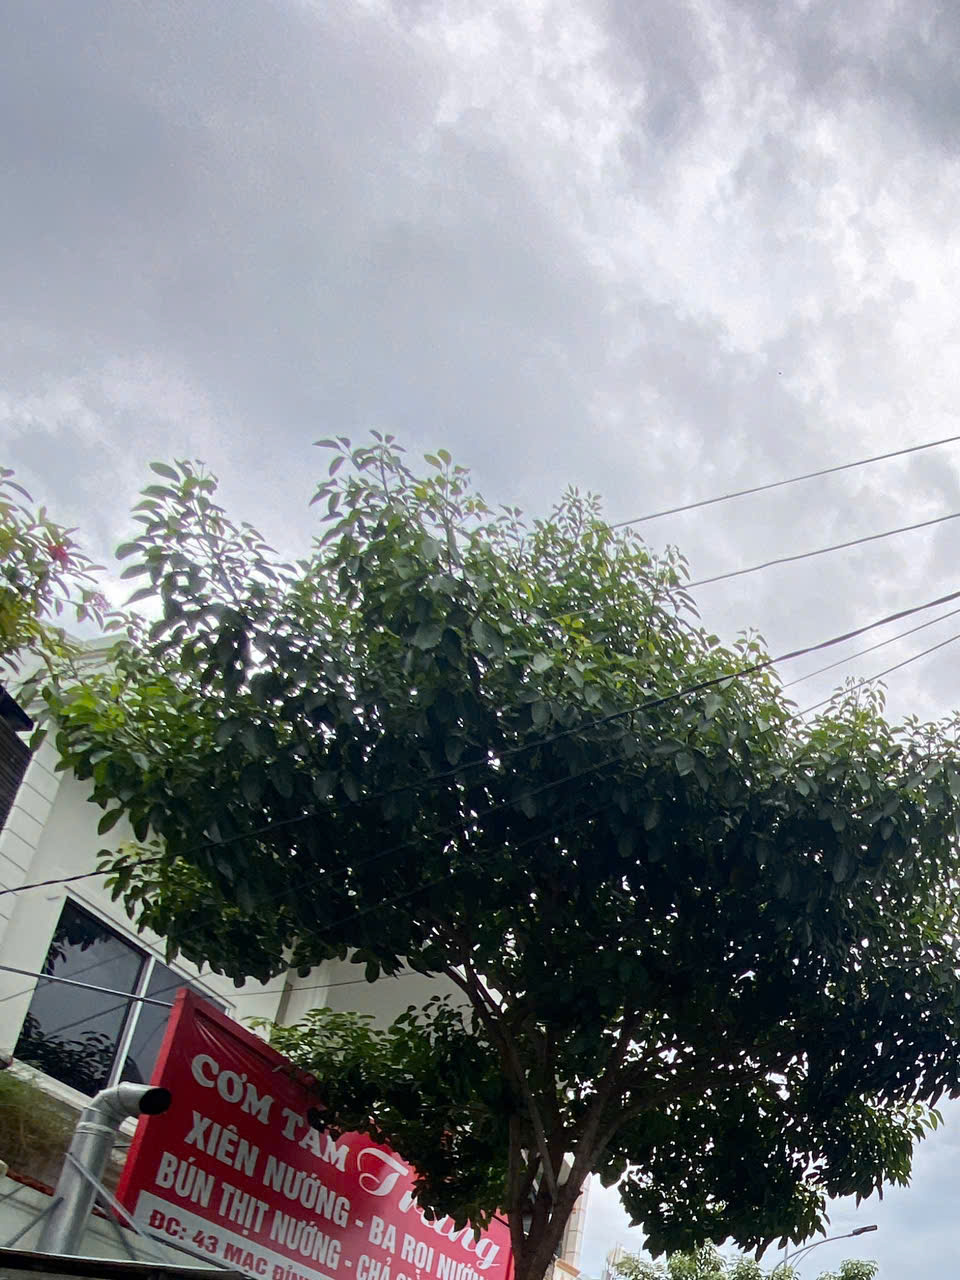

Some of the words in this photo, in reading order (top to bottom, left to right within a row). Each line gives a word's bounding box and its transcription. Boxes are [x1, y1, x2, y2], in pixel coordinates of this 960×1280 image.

[191, 1054, 275, 1125] CƠM
[155, 1151, 216, 1209] BÚN
[217, 1181, 271, 1236] THỊT
[270, 1209, 342, 1271] NƯỚNG
[184, 1110, 259, 1177] XIÊN
[262, 1154, 351, 1229] NƯỚNG
[368, 1215, 397, 1255] BA
[401, 1232, 435, 1274] RỌI
[148, 1209, 187, 1241] ĐC:
[192, 1229, 219, 1254] 43
[223, 1242, 268, 1276] MẠC
